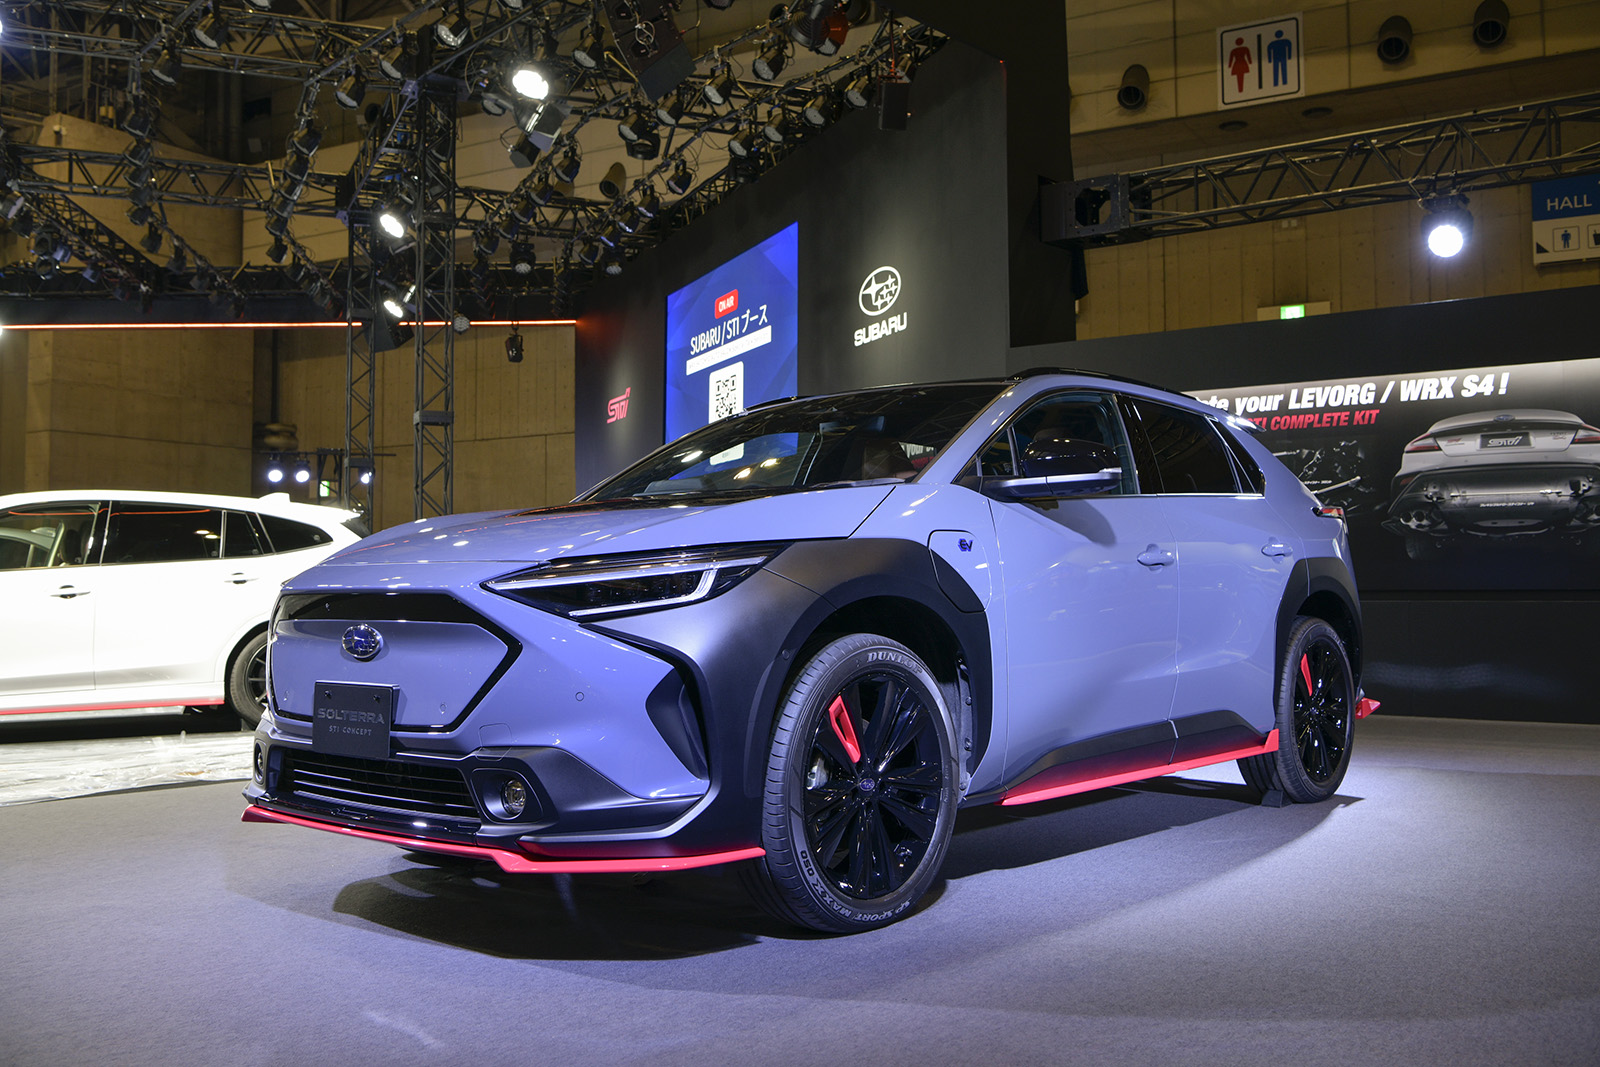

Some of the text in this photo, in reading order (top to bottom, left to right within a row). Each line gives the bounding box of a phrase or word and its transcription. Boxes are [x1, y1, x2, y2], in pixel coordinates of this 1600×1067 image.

[1546, 194, 1592, 211] HALL
[741, 304, 768, 333] ブース
[854, 311, 907, 347] SUBARU
[1234, 394, 1284, 416] your
[1288, 382, 1376, 409] LEVORG
[1400, 376, 1457, 401] WRX
[1270, 411, 1350, 430] COMPLETE
[1353, 409, 1380, 425] KIT
[867, 651, 923, 674] DUNLOP
[317, 707, 384, 724] SOLTERRA
[329, 725, 372, 736] STI CONCEPT
[811, 877, 852, 917] MAXX
[852, 908, 894, 922] SPORT
